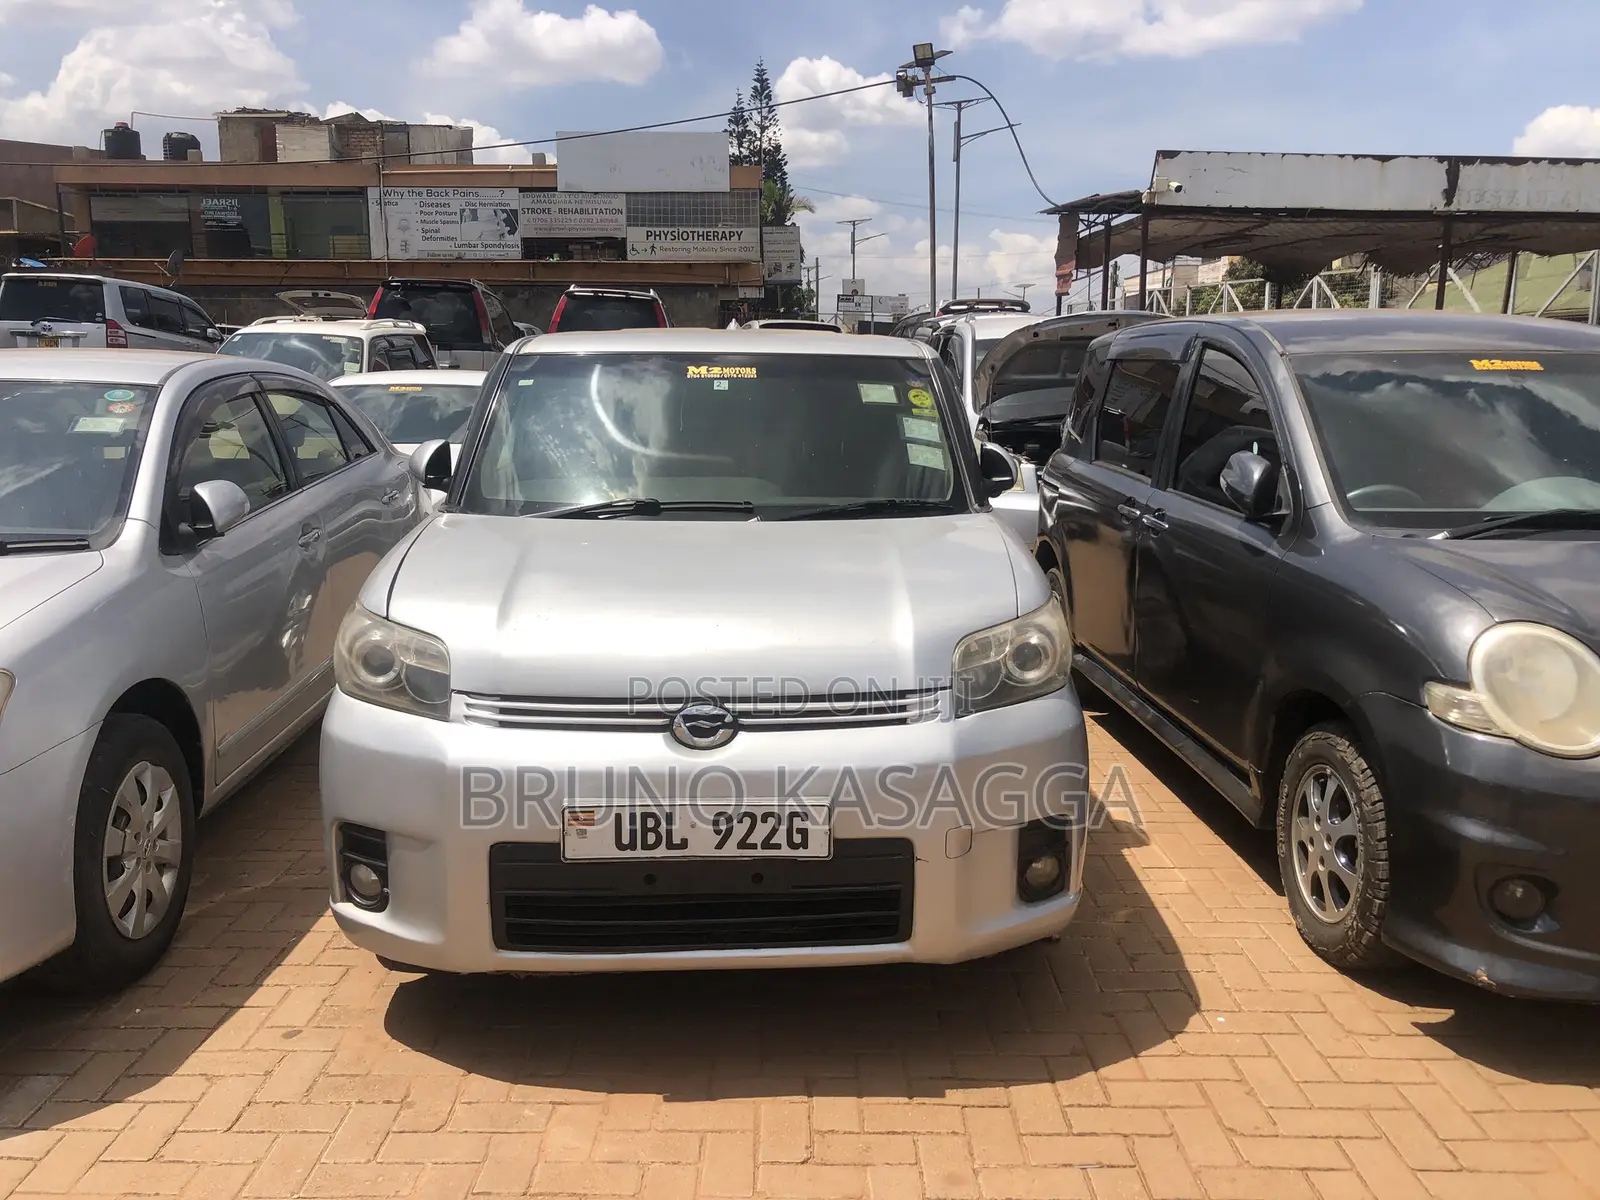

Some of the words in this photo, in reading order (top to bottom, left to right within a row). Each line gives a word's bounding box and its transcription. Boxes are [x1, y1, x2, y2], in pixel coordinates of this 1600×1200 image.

[383, 189, 404, 199] Why
[407, 189, 423, 198] the
[426, 189, 450, 198] Back
[521, 207, 552, 215] STROKE
[558, 207, 623, 215] REHABILITATION
[659, 246, 691, 254] Restoring
[614, 812, 689, 851] UBL
[712, 812, 809, 850] 922G
